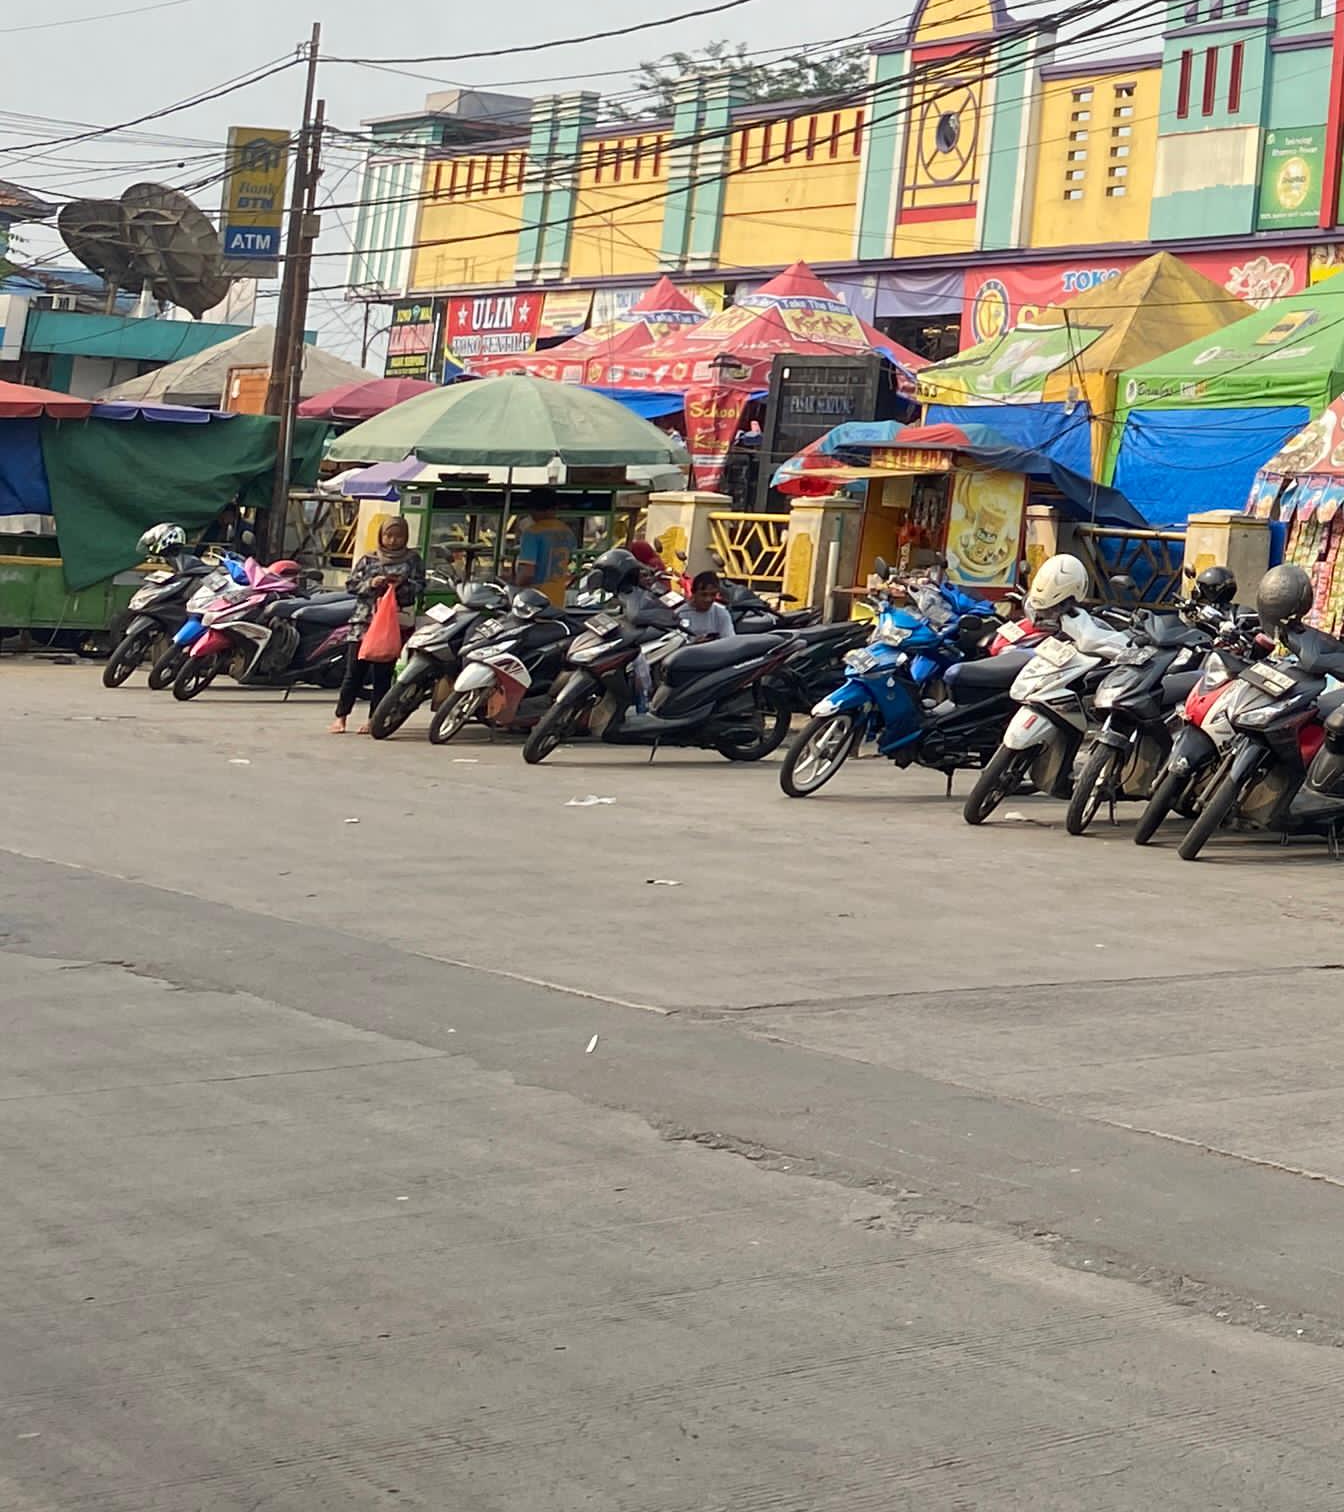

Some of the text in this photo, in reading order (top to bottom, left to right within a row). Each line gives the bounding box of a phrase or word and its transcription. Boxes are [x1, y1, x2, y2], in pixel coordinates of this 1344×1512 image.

[230, 233, 271, 250] ATM
[471, 296, 517, 330] ULIN
[689, 399, 741, 420] School
